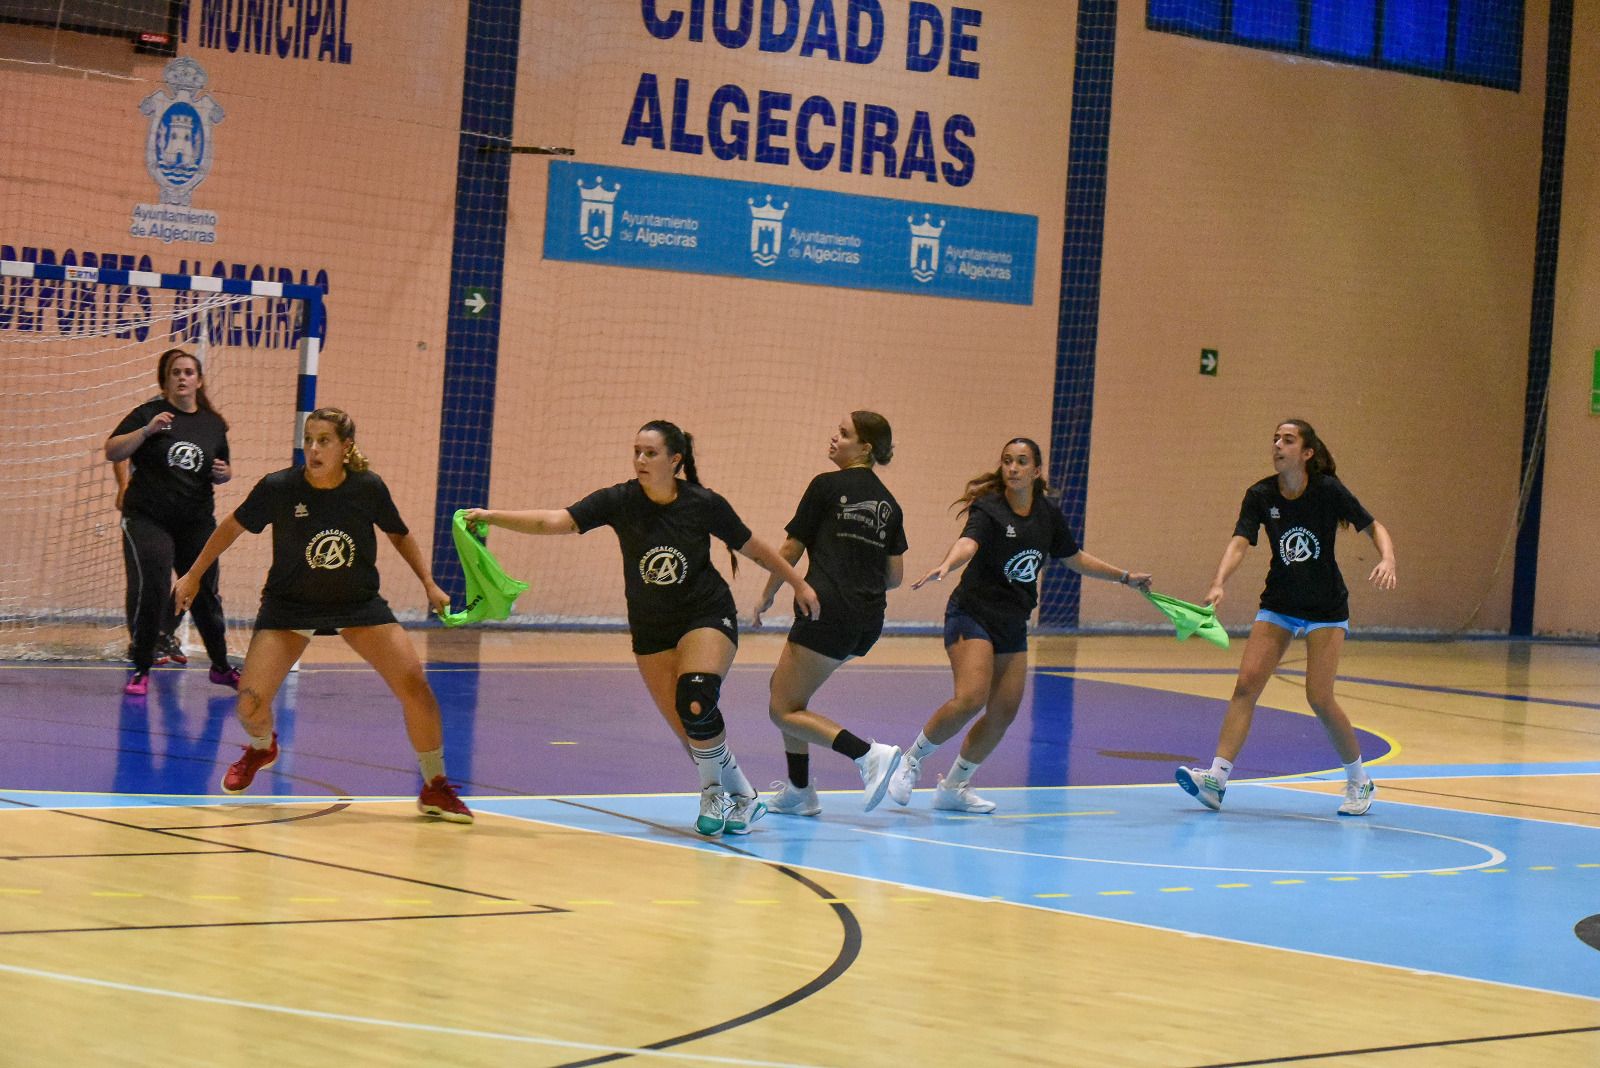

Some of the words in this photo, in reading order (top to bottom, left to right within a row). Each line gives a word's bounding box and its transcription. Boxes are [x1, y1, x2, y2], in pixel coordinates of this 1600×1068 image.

[199, 0, 352, 64] MUNICIPAL
[641, 0, 884, 65] CIUDAD
[906, 0, 982, 79] DE
[621, 72, 976, 187] ALGECIRAS
[134, 205, 216, 226] Ayuntamiento
[621, 210, 698, 231] Ayuntamiento
[131, 224, 146, 237] de
[148, 223, 215, 243] Algeciras
[635, 227, 698, 248] Algeciras
[789, 228, 861, 248] Ayuntamiento
[803, 245, 861, 264] Algeciras
[945, 245, 1013, 264] Ayuntamiento
[958, 261, 1011, 280] Algeciras
[0, 245, 153, 342] DEPORTES
